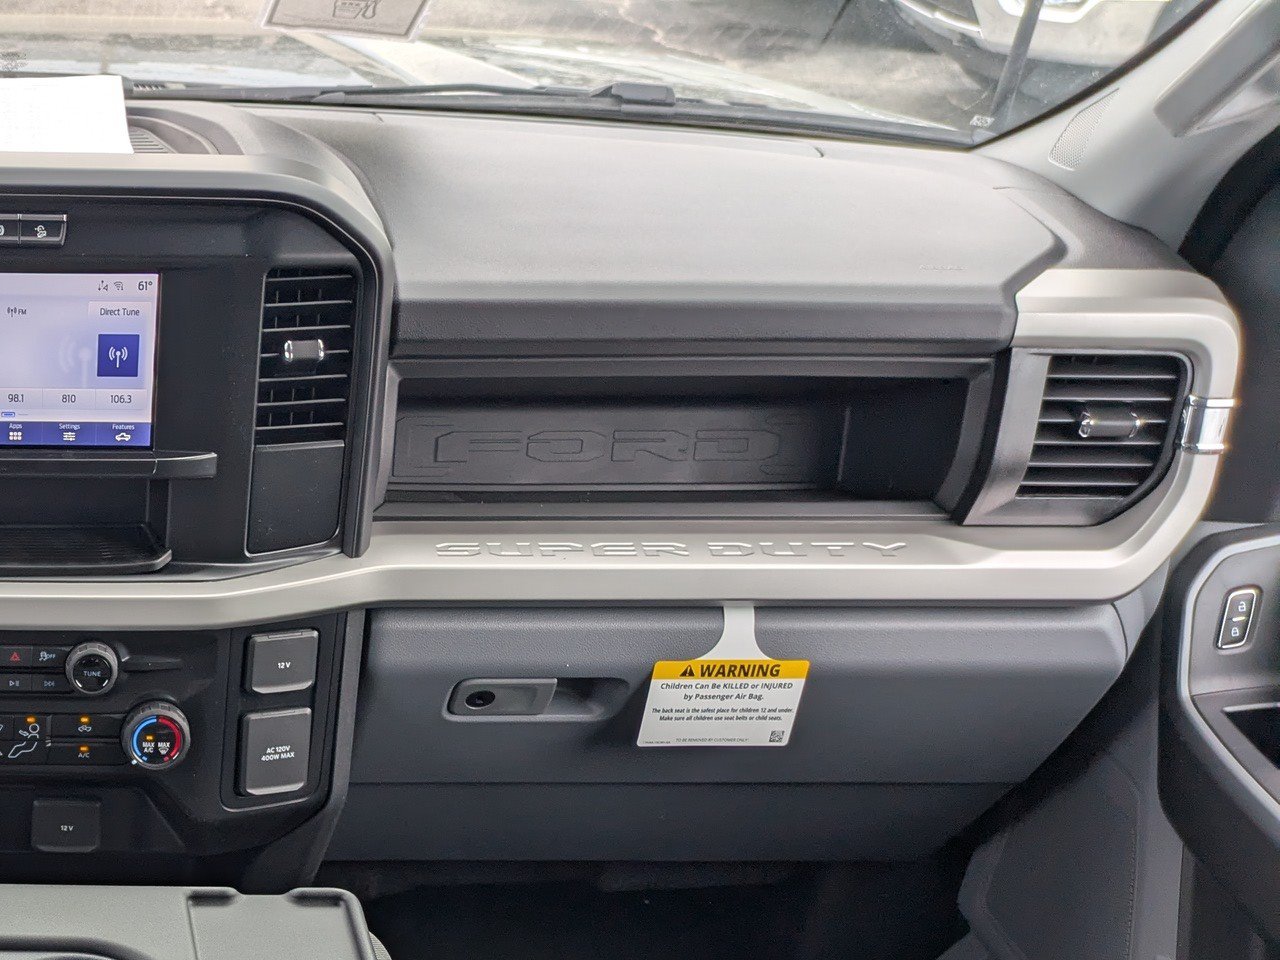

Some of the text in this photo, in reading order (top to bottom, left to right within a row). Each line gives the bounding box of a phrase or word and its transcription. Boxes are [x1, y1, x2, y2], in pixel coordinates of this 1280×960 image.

[99, 307, 140, 316] Direct Tune
[7, 393, 24, 403] 98.1
[61, 394, 77, 403] 810
[110, 395, 132, 404] 106.3
[433, 429, 780, 463] FORD
[435, 542, 907, 557] SUPER DUTY
[699, 664, 781, 678] WARNING
[683, 693, 693, 701] by
[694, 693, 733, 701] Passenger
[748, 693, 764, 701] Bag.
[275, 745, 291, 753] 120V
